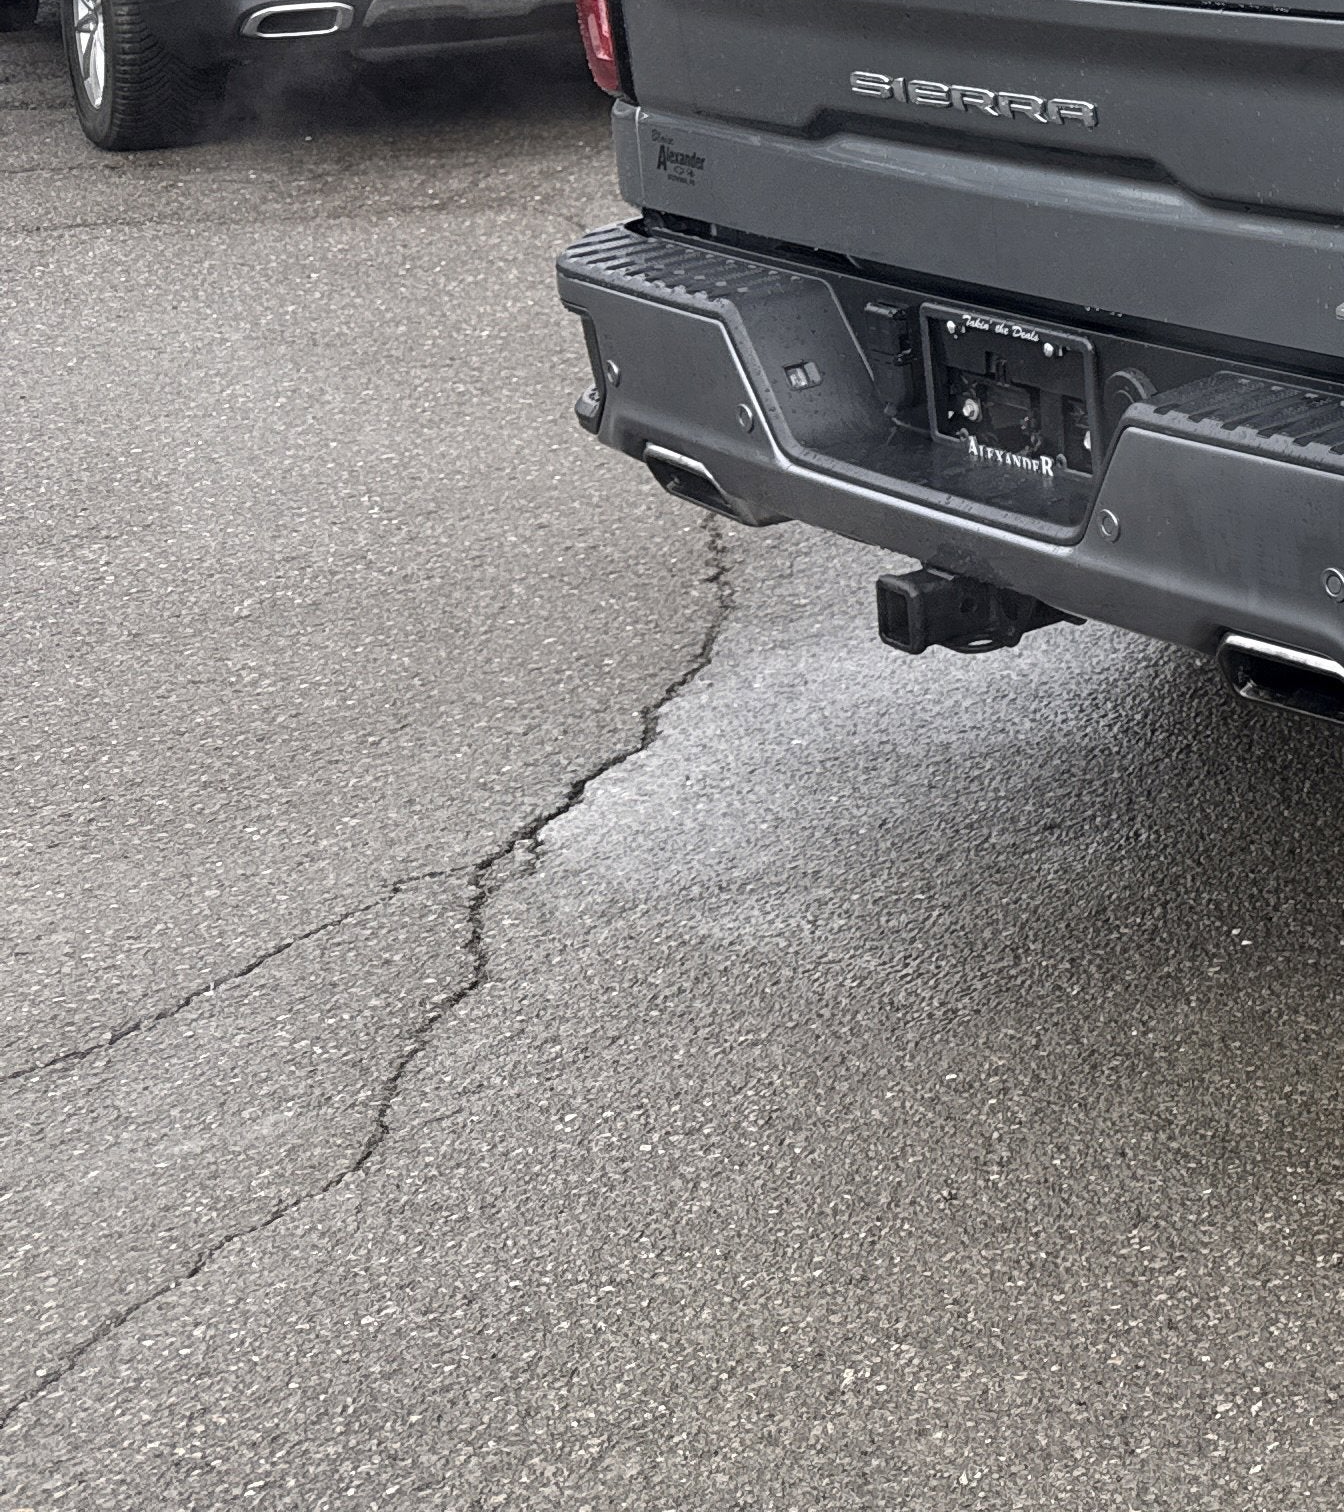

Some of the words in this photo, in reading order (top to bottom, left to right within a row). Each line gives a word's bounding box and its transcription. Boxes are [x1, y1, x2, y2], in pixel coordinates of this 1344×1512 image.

[850, 71, 1098, 131] SIERRA
[962, 314, 993, 331] Takin'
[994, 322, 1009, 336] the
[1011, 325, 1040, 342] Deals
